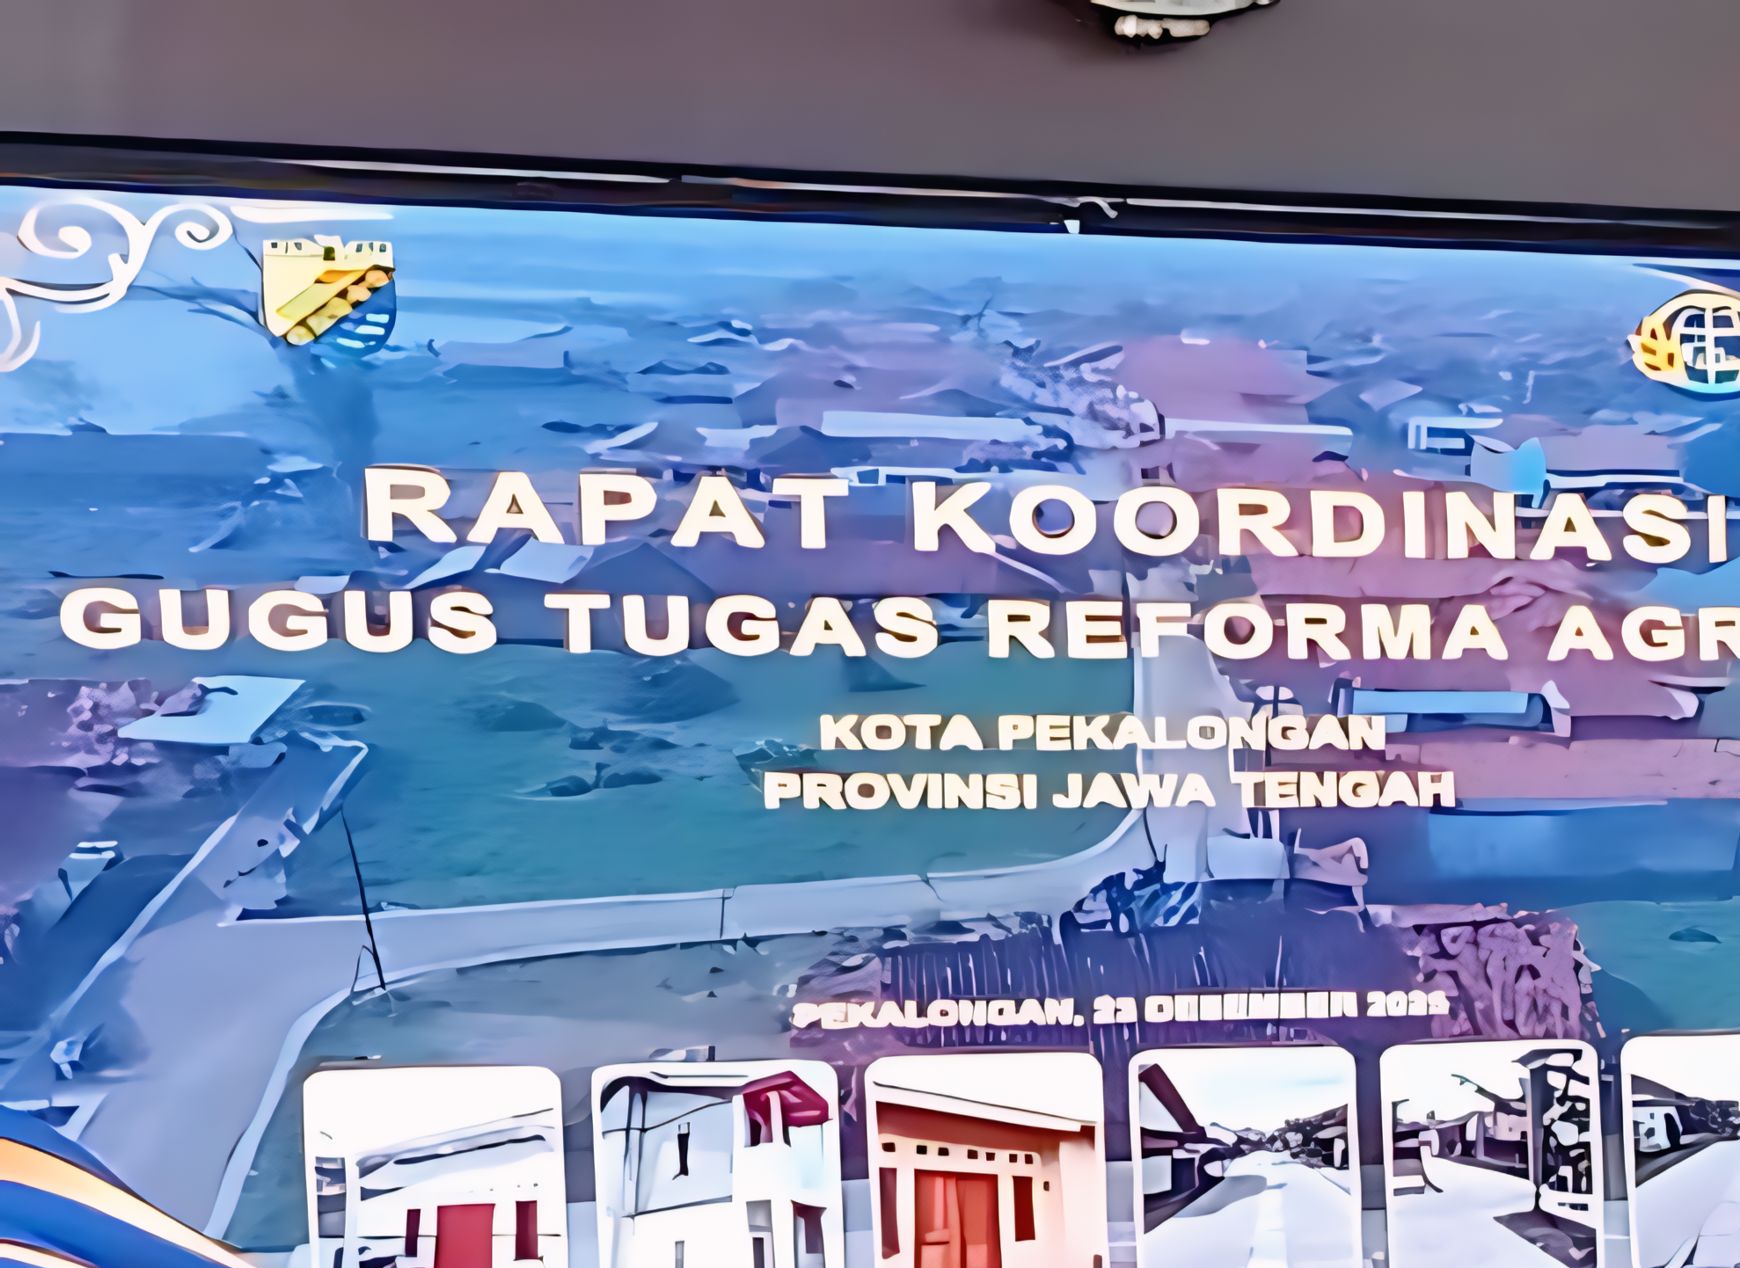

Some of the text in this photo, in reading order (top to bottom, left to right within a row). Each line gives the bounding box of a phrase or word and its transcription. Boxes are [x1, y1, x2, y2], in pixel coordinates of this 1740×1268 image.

[363, 465, 1729, 564] RAPAT KOORDINASI
[58, 587, 499, 655] GUGUS
[543, 594, 939, 659] TUGAS
[986, 600, 1510, 661] REFORMA
[819, 713, 1386, 751] KOTA PEKALONGAN
[763, 770, 1455, 810] PROVINSI JAWA TENGAH
